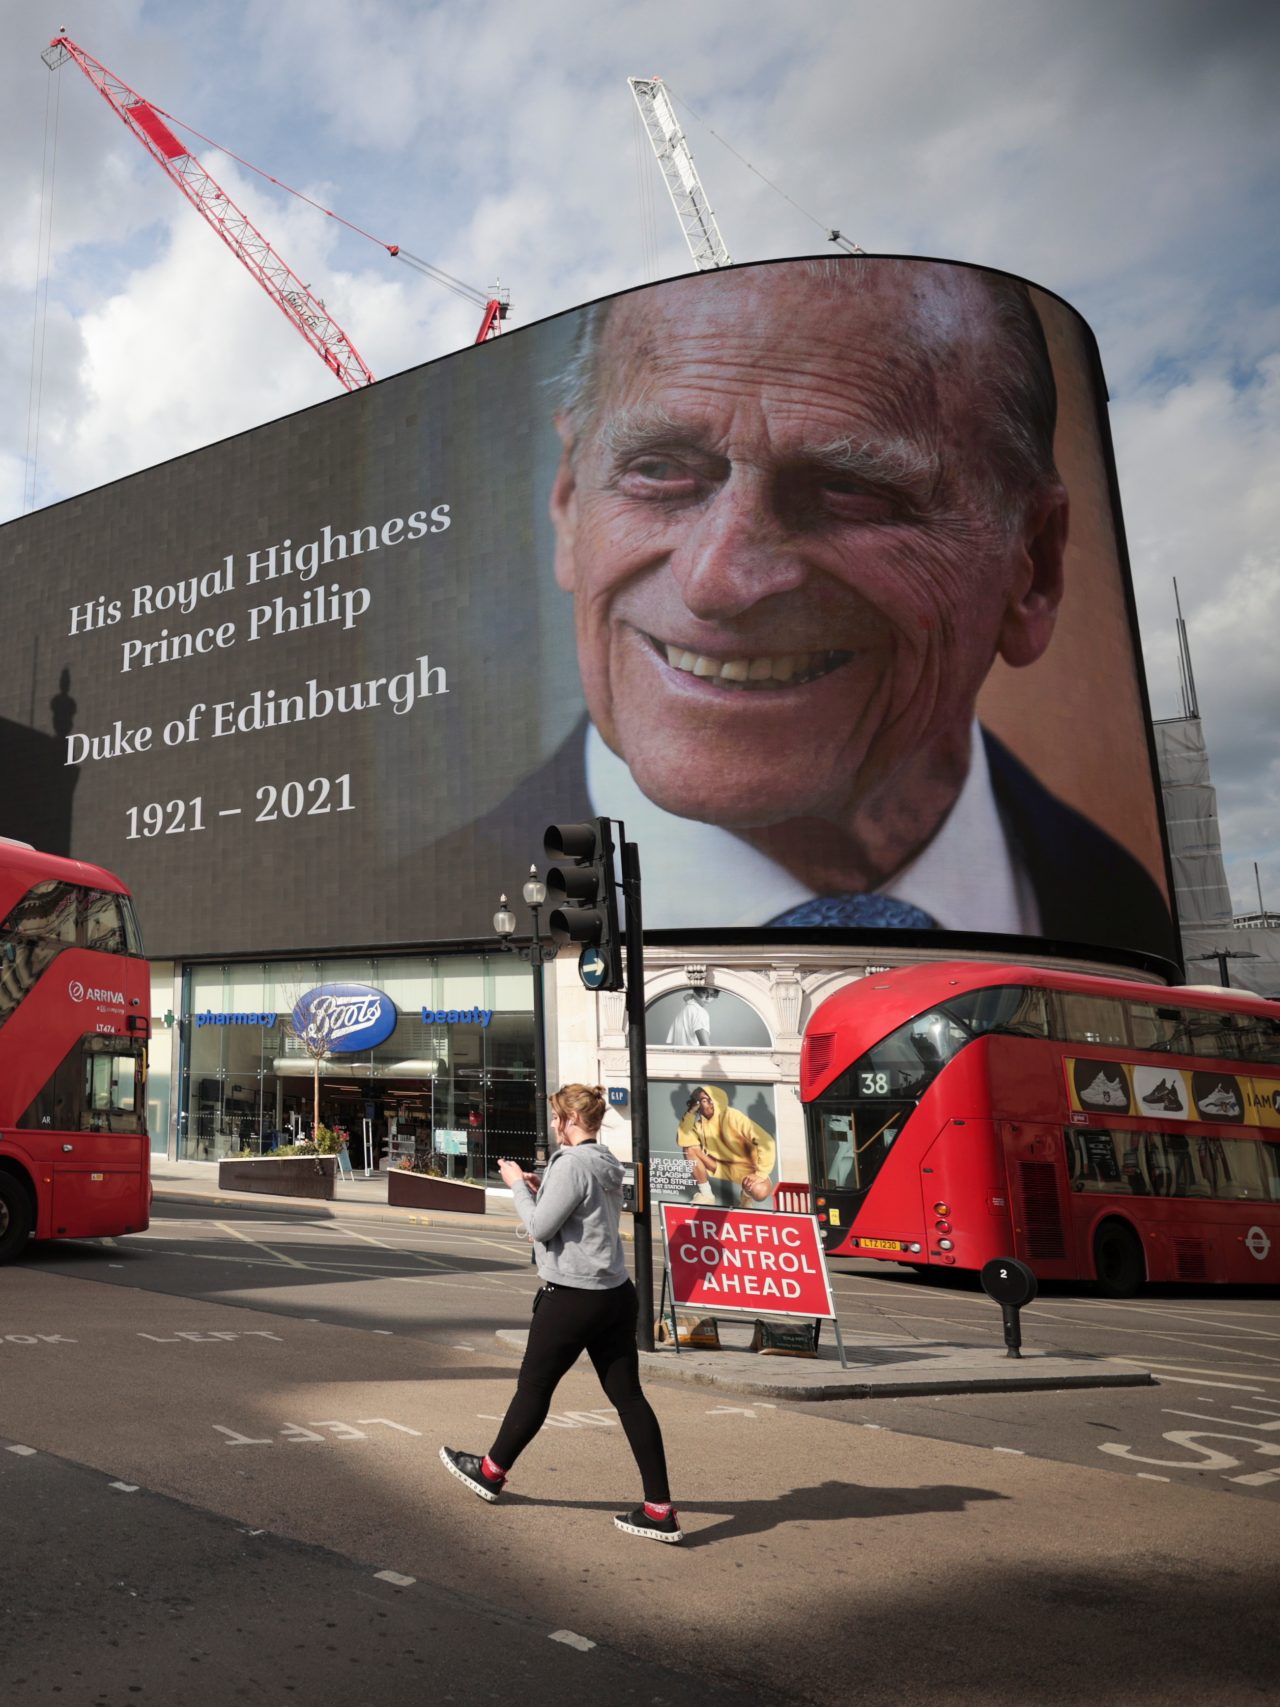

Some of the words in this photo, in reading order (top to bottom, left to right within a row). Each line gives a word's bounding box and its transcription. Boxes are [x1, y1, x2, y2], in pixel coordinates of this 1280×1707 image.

[68, 596, 122, 636] His
[131, 555, 235, 618] Royal
[246, 504, 451, 586] Highness
[120, 622, 236, 673] Prince
[247, 583, 371, 642] Philip
[63, 720, 153, 766] Duke
[163, 702, 208, 746] of
[211, 654, 450, 738] Edinburgh
[126, 796, 206, 840] 1921
[255, 773, 356, 822] 2021
[86, 988, 125, 1005] ARRIVA
[196, 1009, 278, 1028] pharmacy
[302, 995, 382, 1040] Boots
[421, 1006, 493, 1028] beauty
[96, 1024, 115, 1033] LT474
[861, 1073, 889, 1094] 38
[610, 1091, 624, 1101] GAP
[1253, 1094, 1272, 1108] AM
[41, 1115, 51, 1124] AR
[649, 1157, 661, 1165] UR
[662, 1158, 698, 1166] CLOSEST
[657, 1164, 683, 1172] STORE
[649, 1176, 669, 1184] FORD
[670, 1178, 698, 1186] STREET
[684, 1219, 801, 1247] TRAFFIC
[680, 1244, 817, 1274] CONTROL
[999, 1268, 1008, 1279] 2
[702, 1272, 801, 1299] AHEAD
[135, 1330, 284, 1343] LEFT
[211, 1418, 423, 1446] LEFT
